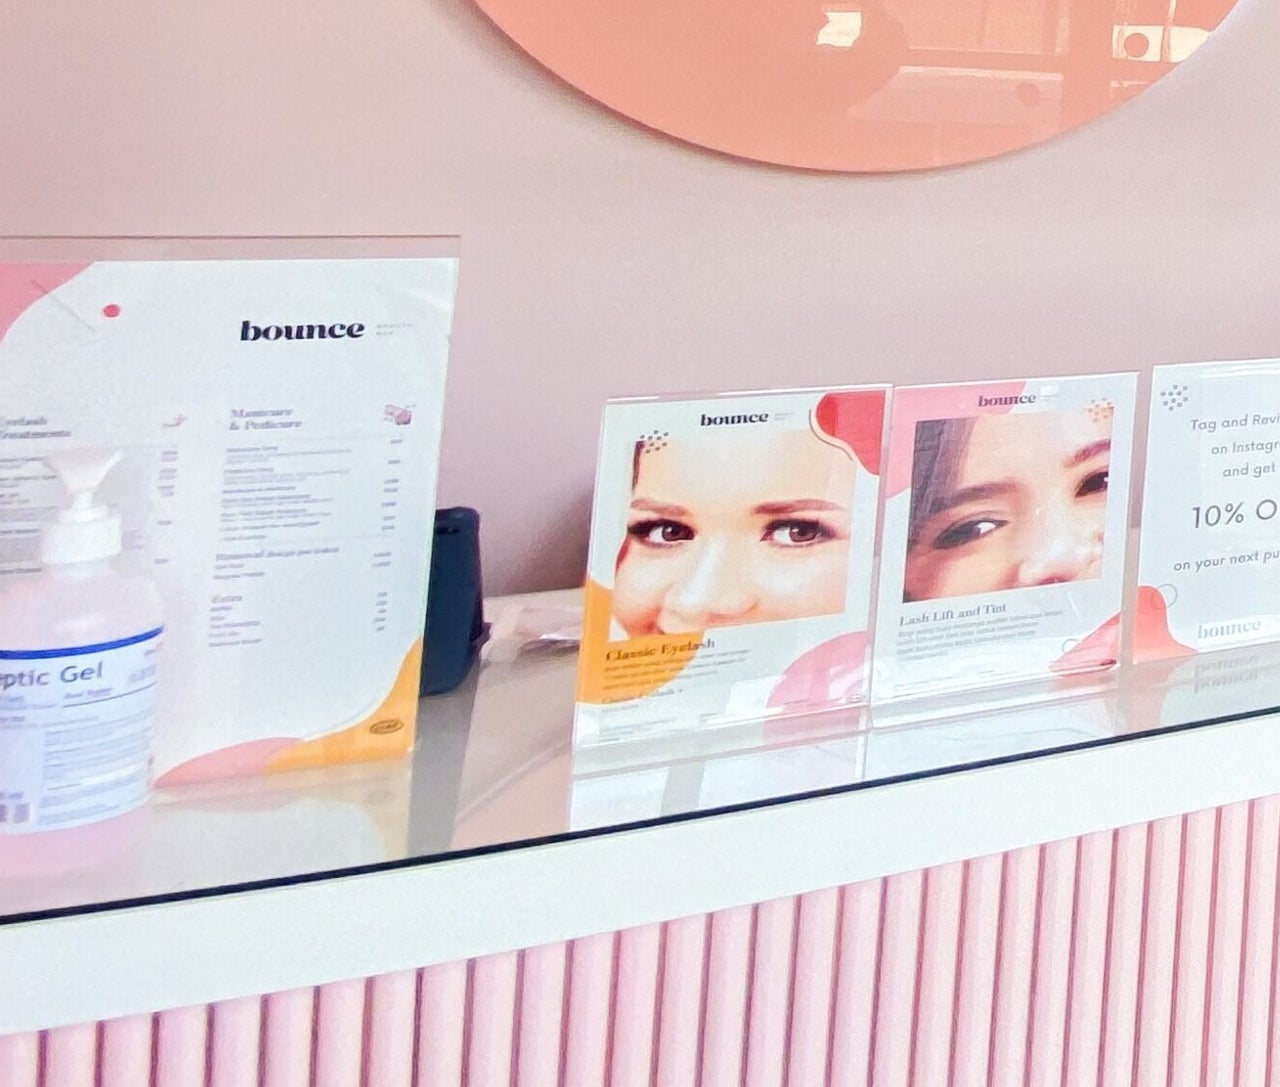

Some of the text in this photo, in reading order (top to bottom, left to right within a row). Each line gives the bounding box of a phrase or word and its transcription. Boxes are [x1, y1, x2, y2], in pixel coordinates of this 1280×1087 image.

[240, 320, 366, 342] bounce
[978, 394, 1037, 407] bounce
[700, 413, 769, 427] bounce
[1190, 418, 1217, 433] Tag
[1220, 413, 1248, 428] and
[1210, 445, 1228, 455] on
[1222, 461, 1277, 479] and get
[1191, 501, 1245, 529] 10%
[1173, 561, 1191, 572] on
[1195, 557, 1226, 573] your
[1229, 550, 1259, 564] next
[899, 603, 1007, 626] Lash Lift and Tint
[1196, 619, 1262, 640] bounce
[605, 638, 716, 662] Classic Eyelash
[0, 668, 50, 691] ptic
[59, 661, 104, 684] Gel
